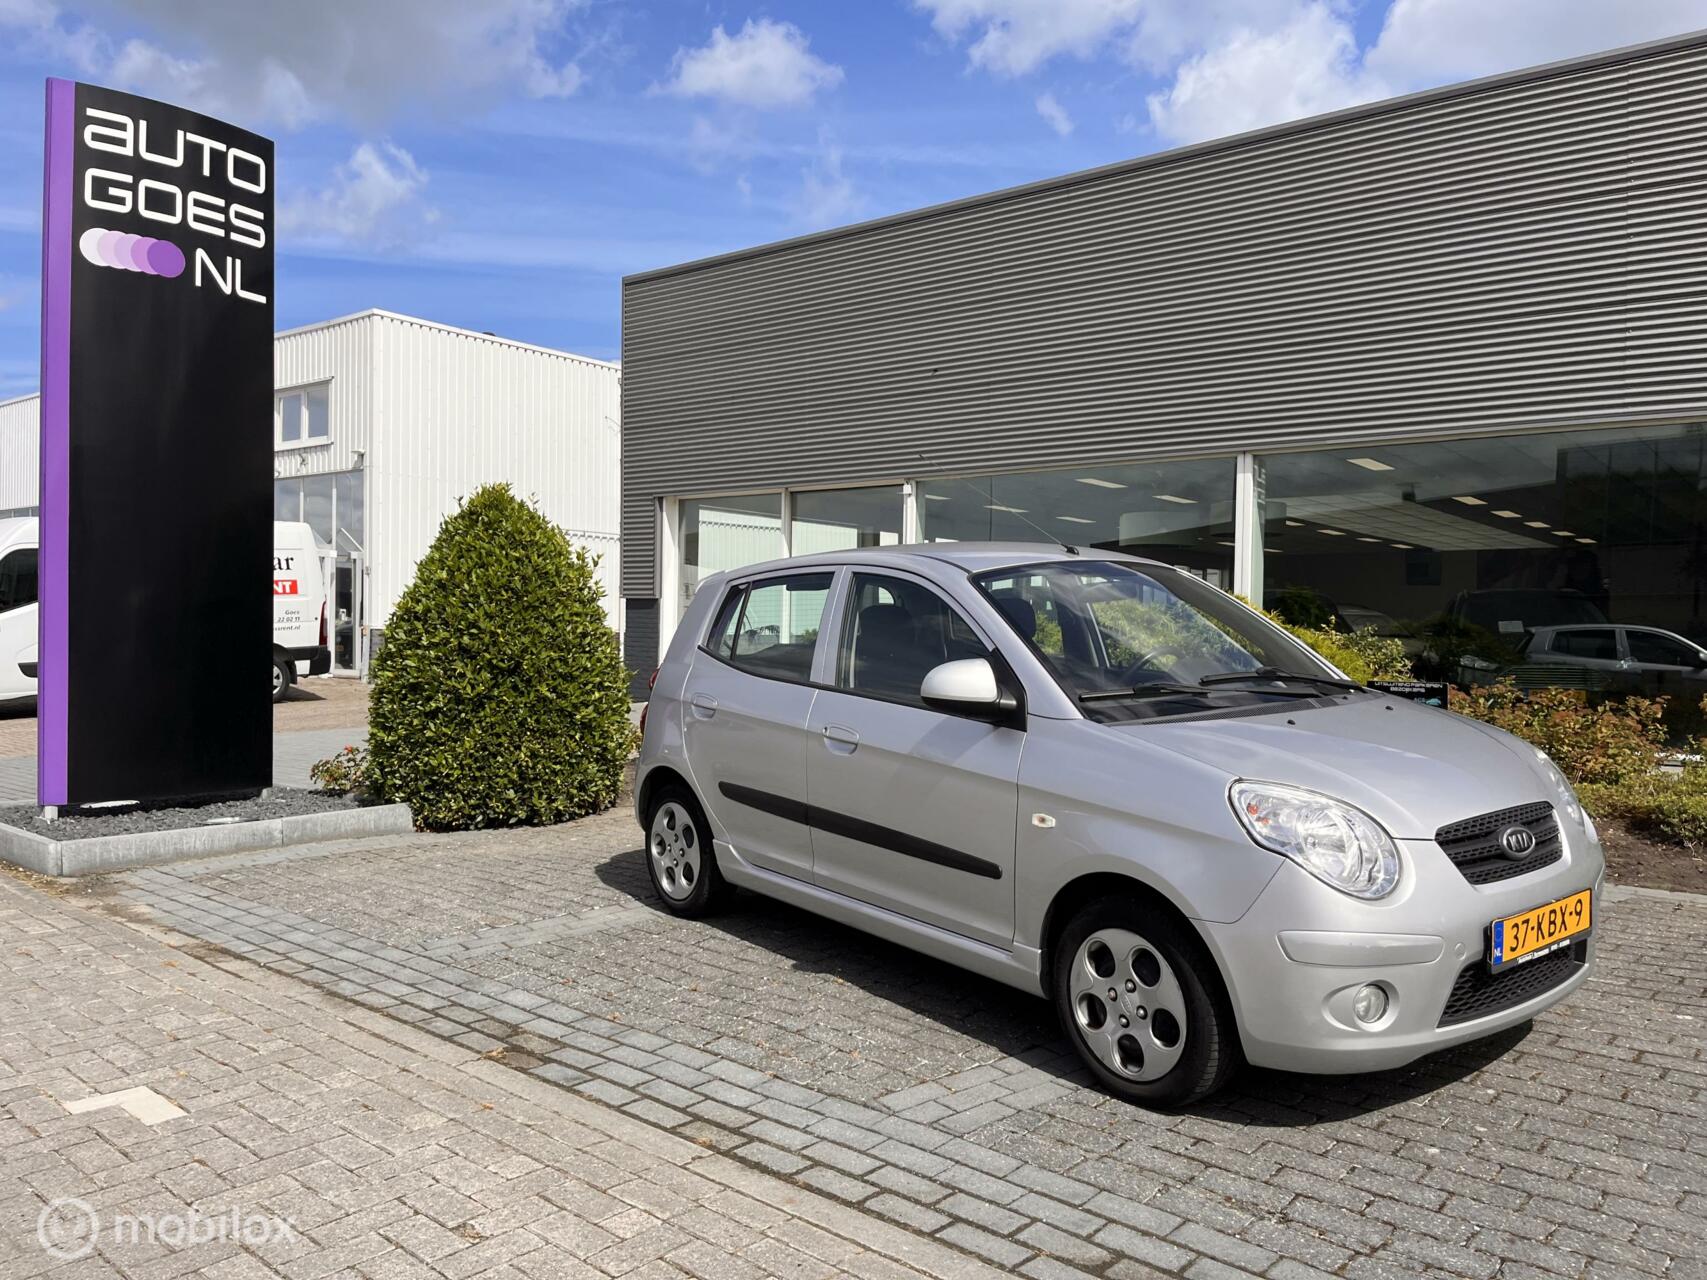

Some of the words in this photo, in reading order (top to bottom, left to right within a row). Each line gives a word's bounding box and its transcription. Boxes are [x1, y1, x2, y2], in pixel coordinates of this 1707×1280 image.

[85, 168, 265, 248] GOES
[195, 247, 267, 304] NL
[1508, 828, 1532, 851] KIA
[1493, 947, 1502, 957] NL
[1509, 898, 1584, 953] 37-KBX-9
